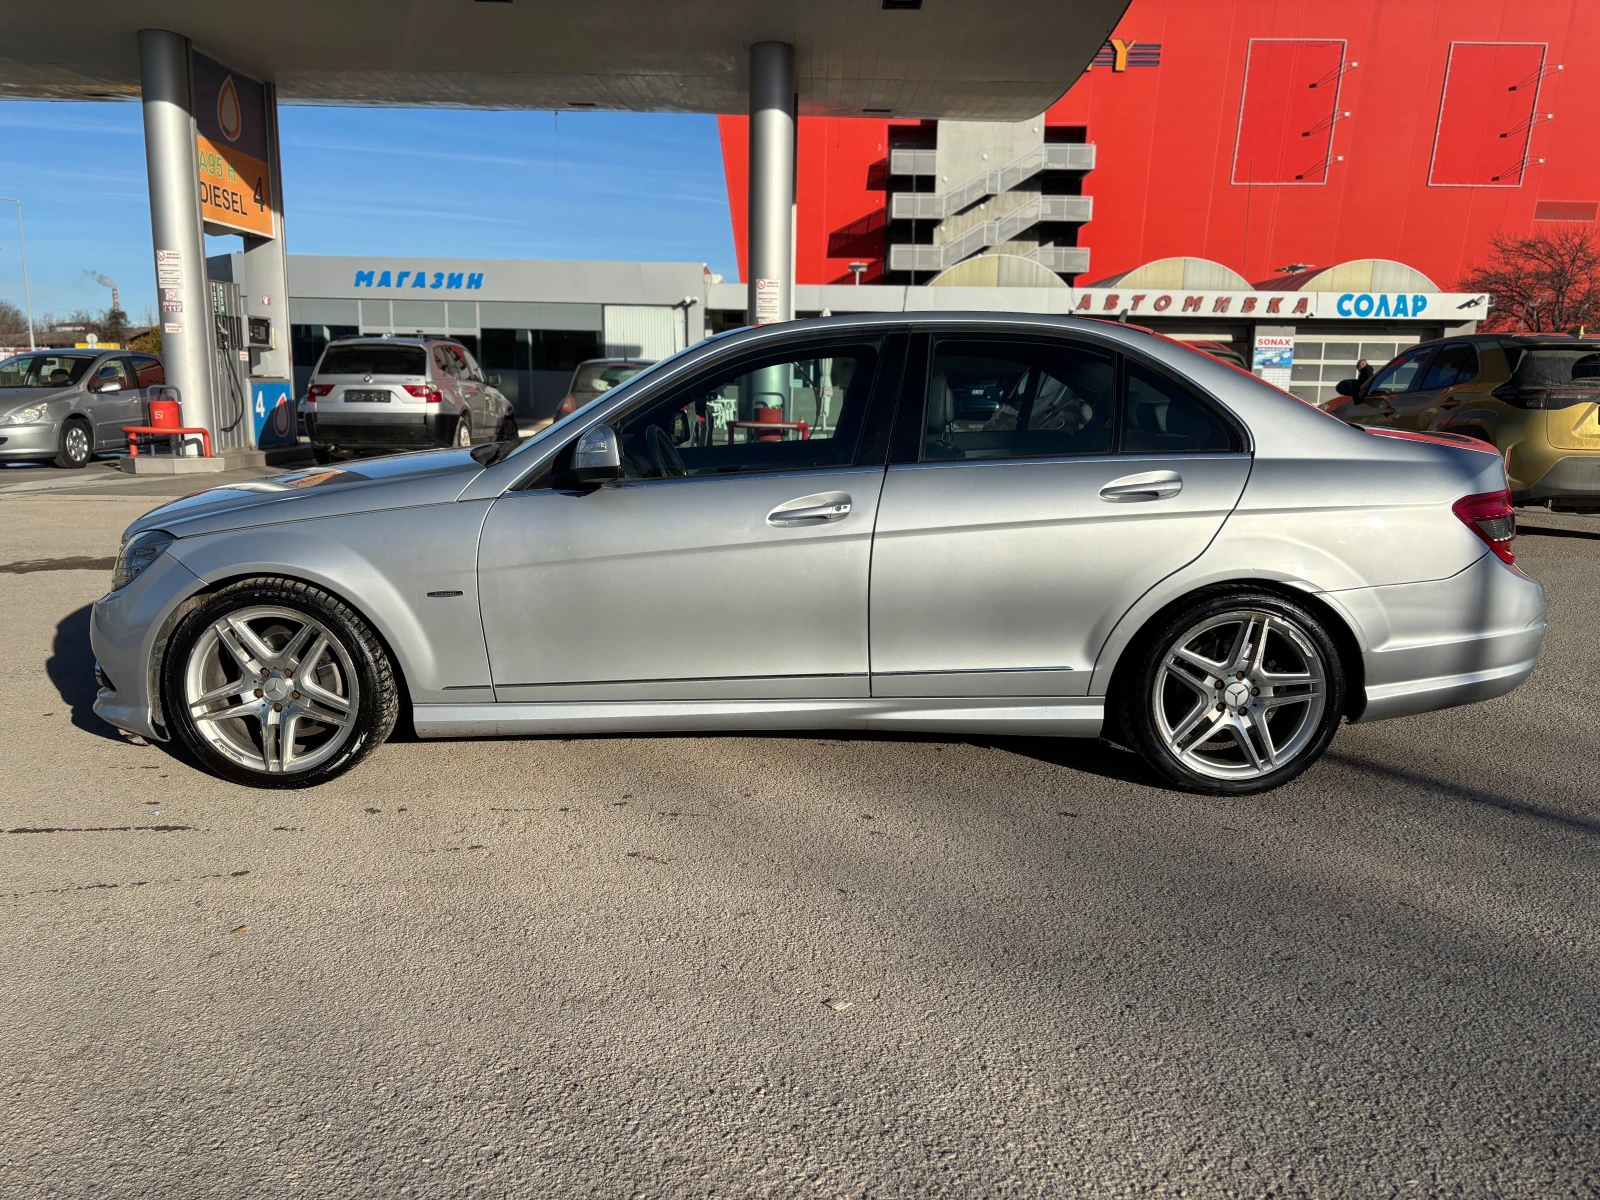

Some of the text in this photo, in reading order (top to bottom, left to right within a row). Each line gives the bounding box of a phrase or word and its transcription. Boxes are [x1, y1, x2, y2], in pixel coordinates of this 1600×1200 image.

[199, 149, 224, 178] A95
[200, 180, 248, 216] DIESEL
[253, 175, 266, 213] 4
[354, 270, 484, 289] МАГАЗИН
[1076, 294, 1309, 314] АВТОМИВКА
[1336, 293, 1428, 318] СОЛАР
[1257, 338, 1291, 346] SONAX
[255, 390, 265, 418] 4
